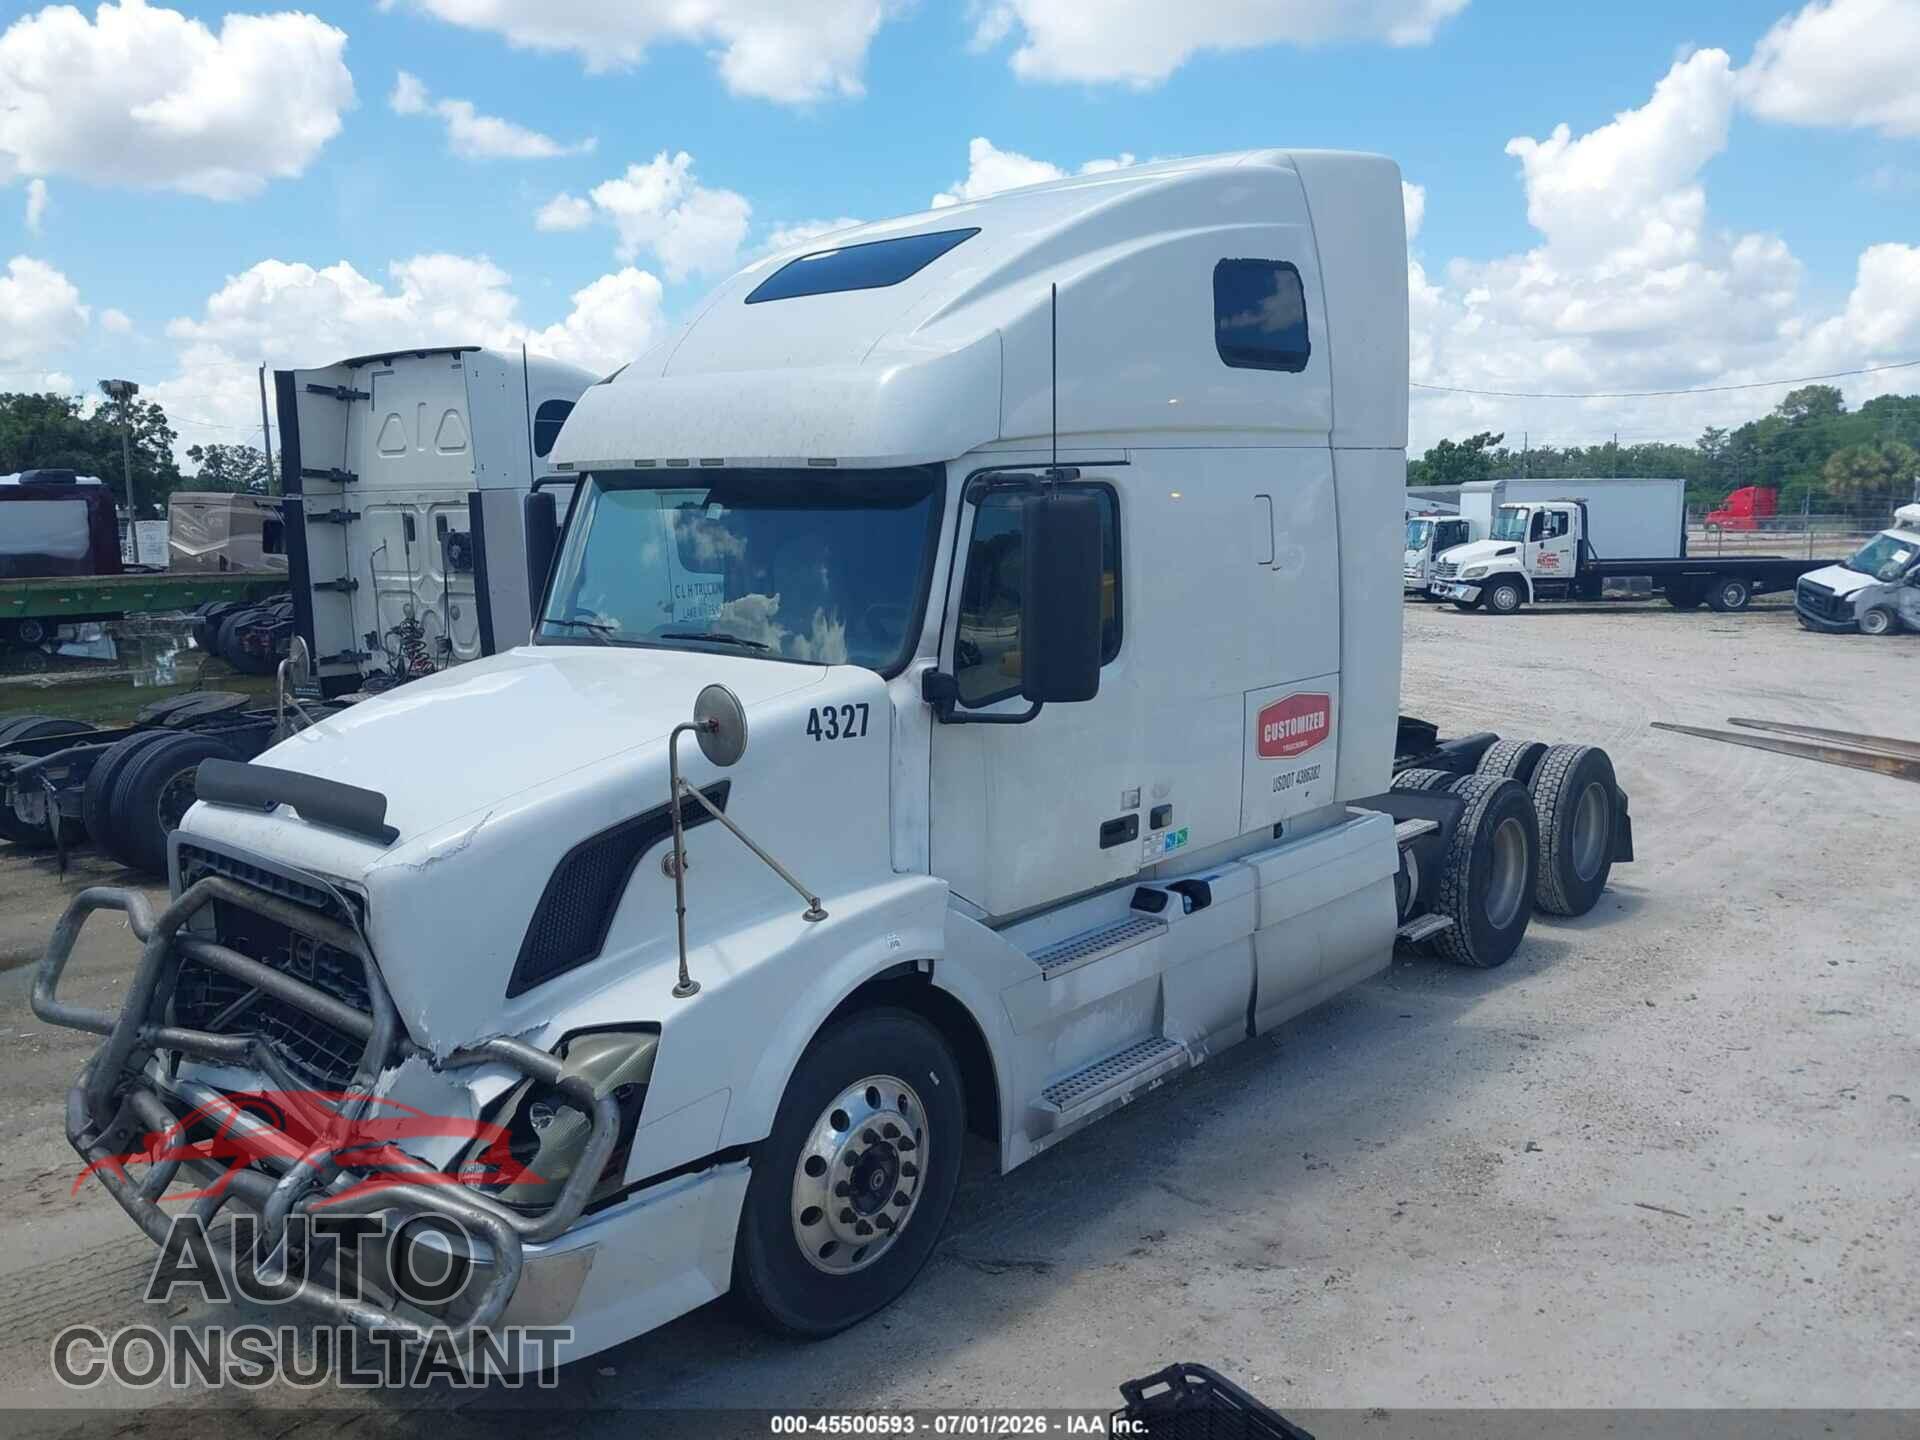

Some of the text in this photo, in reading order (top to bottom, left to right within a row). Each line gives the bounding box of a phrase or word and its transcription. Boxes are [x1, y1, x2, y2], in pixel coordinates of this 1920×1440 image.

[807, 703, 869, 742] 4327
[1264, 711, 1325, 743] CUSTOMIZED
[1273, 772, 1295, 793] USDOT
